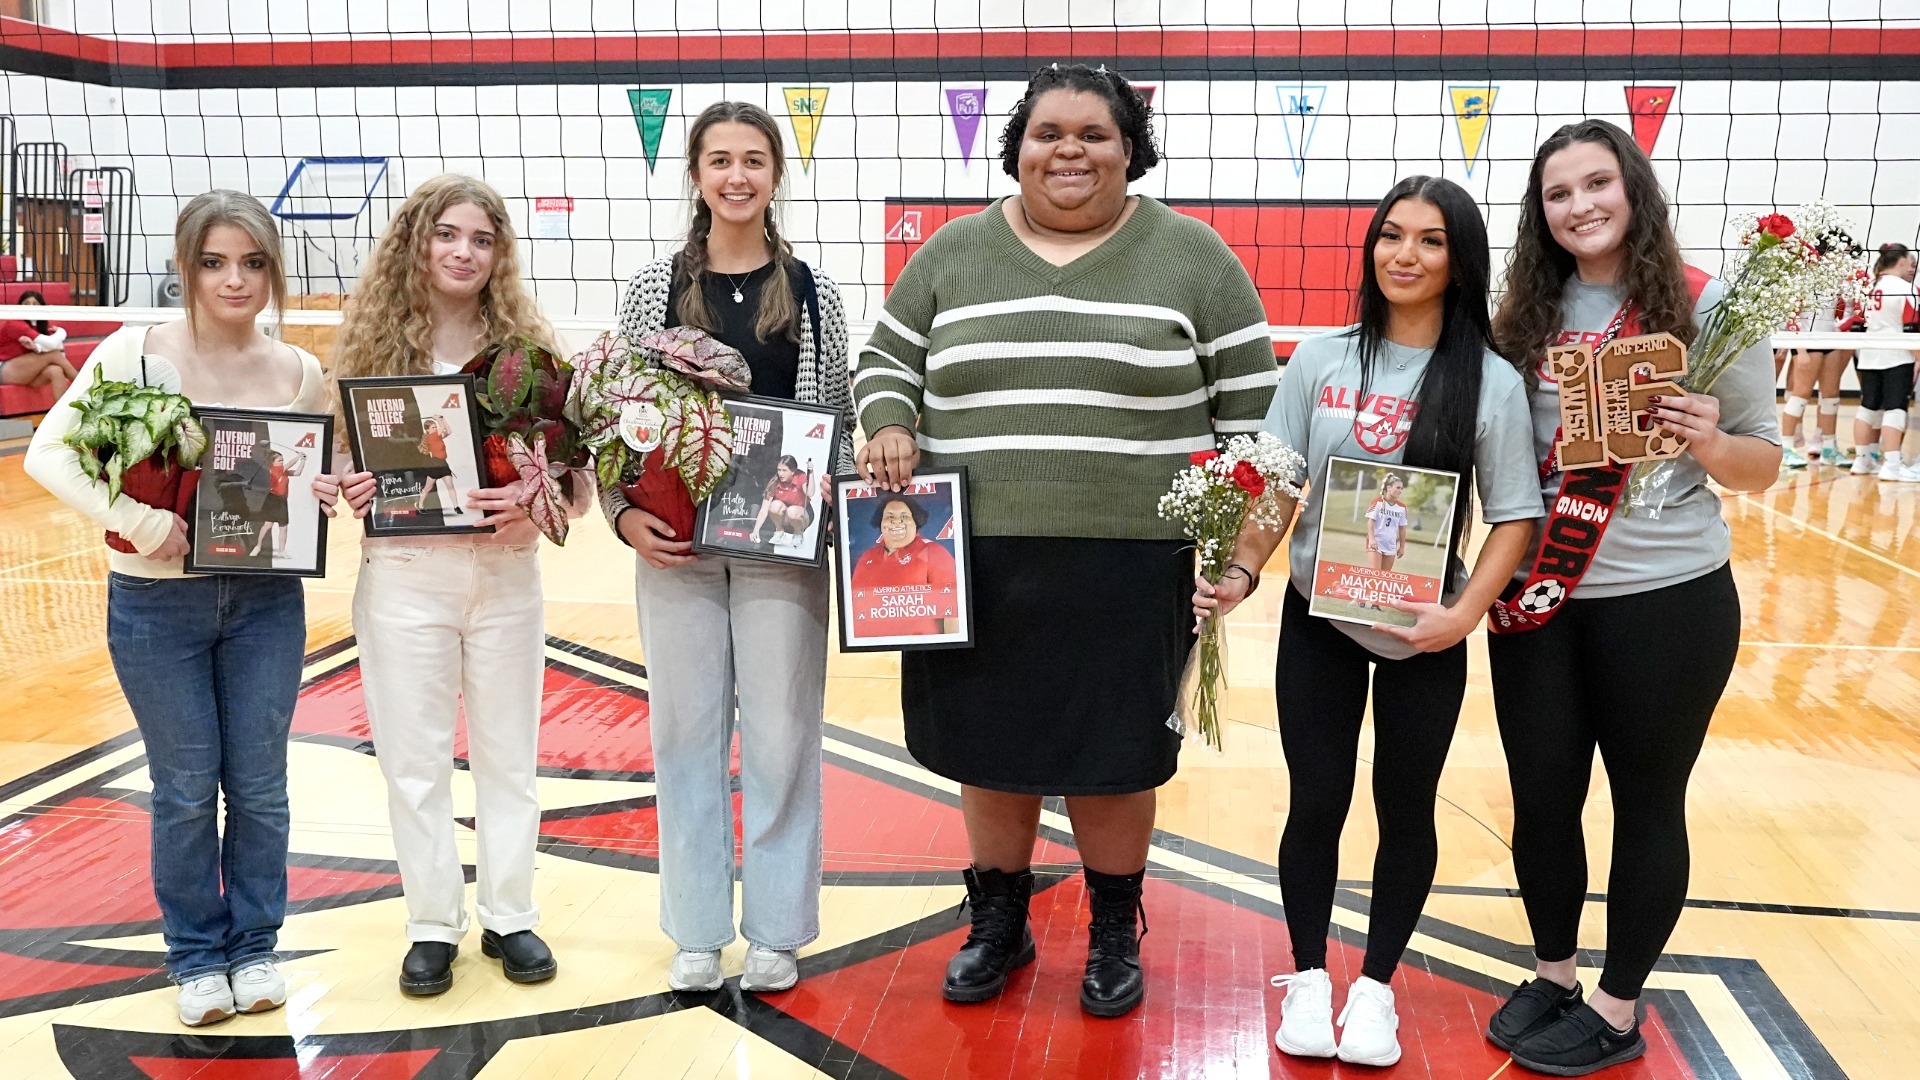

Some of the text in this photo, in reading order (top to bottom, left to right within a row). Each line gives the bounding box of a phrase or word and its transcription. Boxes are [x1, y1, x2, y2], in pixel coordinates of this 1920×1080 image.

[793, 97, 818, 113] SNC
[1613, 338, 1668, 356] INFERNO
[367, 398, 405, 412] ALVERNO
[1318, 385, 1420, 421] ALVER
[1603, 381, 1618, 433] COLLEGE
[1614, 379, 1631, 434] ALVERNO
[368, 411, 404, 425] COLLEGE
[1564, 382, 1590, 442] WISE
[370, 424, 392, 438] GOLF
[733, 415, 771, 433] ALVERNO
[214, 430, 256, 446] ALVERNO
[732, 429, 767, 446] COLLEGE
[214, 444, 252, 458] COLLEGE
[213, 457, 236, 471] GOLF
[721, 492, 746, 509] Haley
[1556, 496, 1609, 524] 2026
[1385, 517, 1392, 527] 3
[1349, 566, 1409, 582] ALVERNO SOCCER
[872, 584, 932, 594] ALVERNO ATHLETICS
[1340, 573, 1414, 597] MAKYNNA
[881, 594, 924, 607] SARAH
[870, 605, 937, 619] ROBINSON
